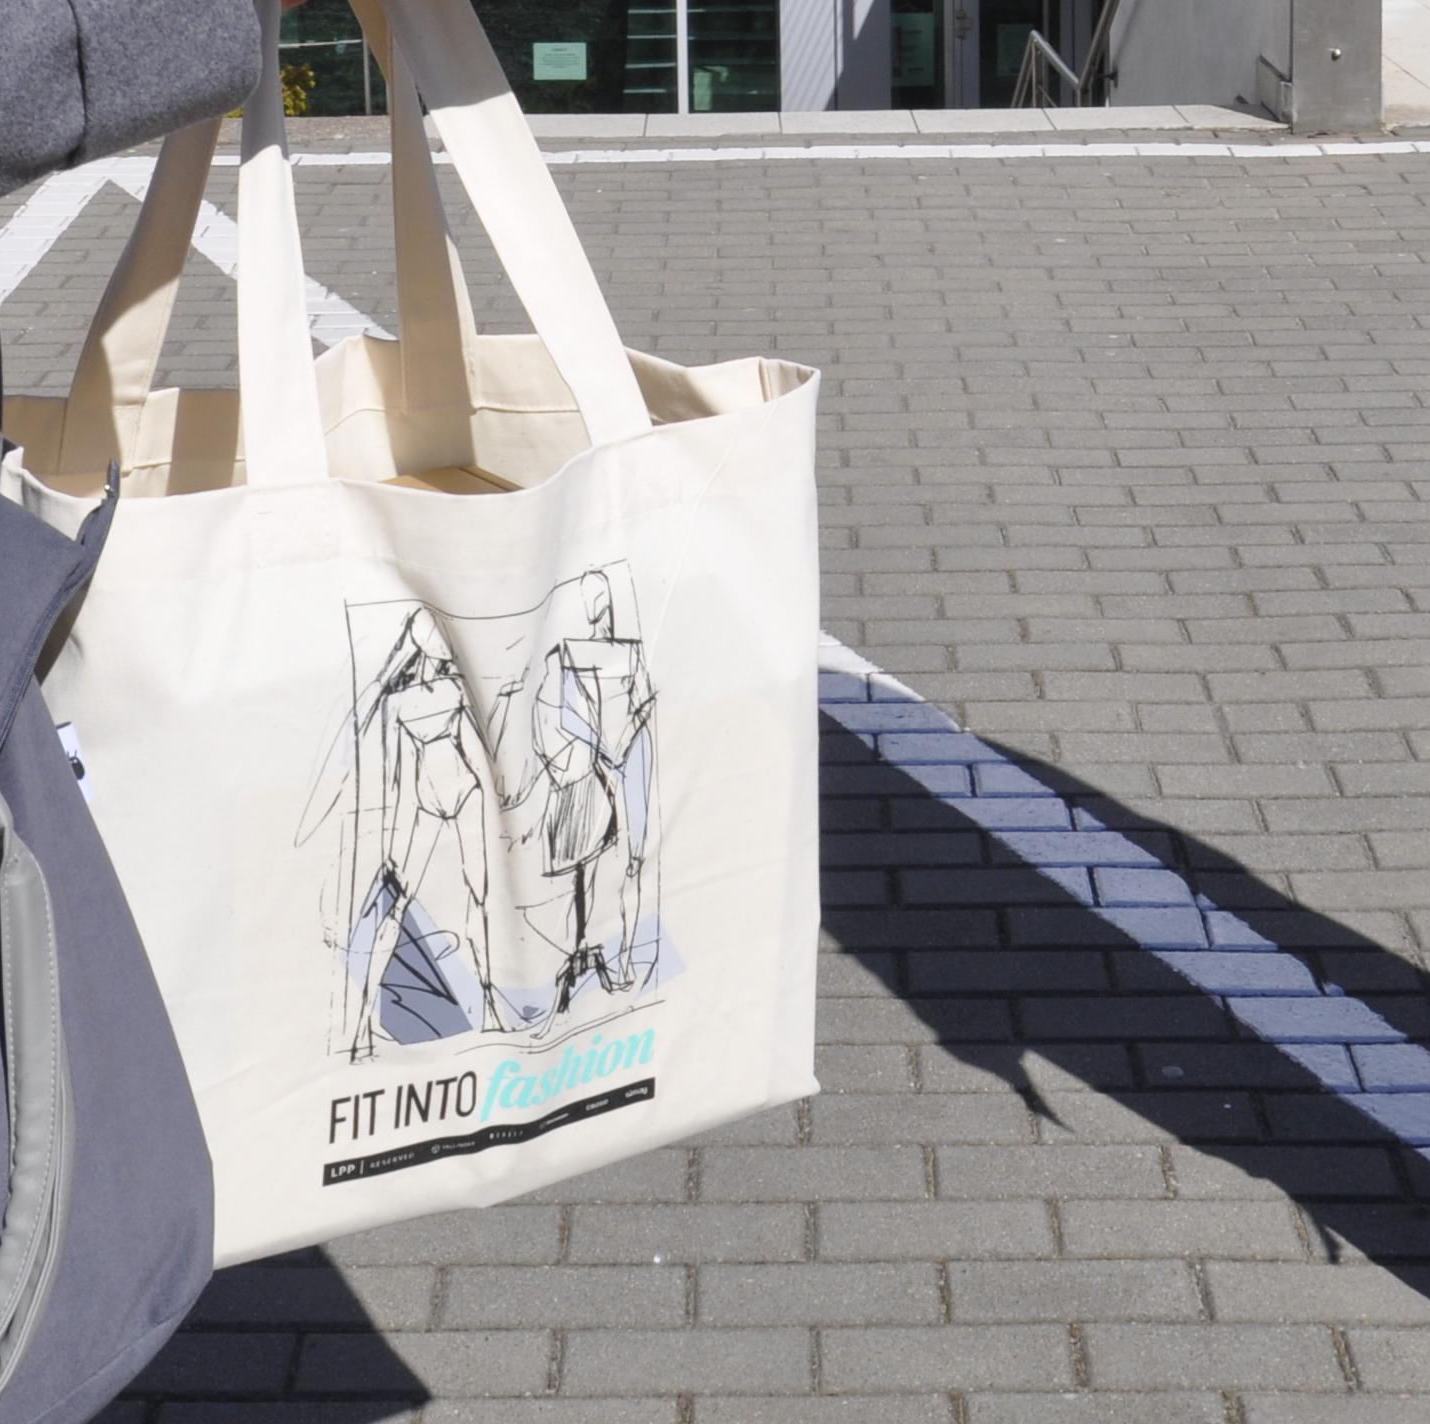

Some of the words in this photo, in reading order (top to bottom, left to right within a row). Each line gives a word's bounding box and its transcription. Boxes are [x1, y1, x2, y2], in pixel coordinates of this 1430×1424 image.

[329, 1089, 385, 1144] FIT
[394, 1071, 477, 1129] INTO
[479, 1028, 656, 1123] fashion
[330, 1164, 356, 1178] LPP
[370, 1152, 415, 1168] RESERVED
